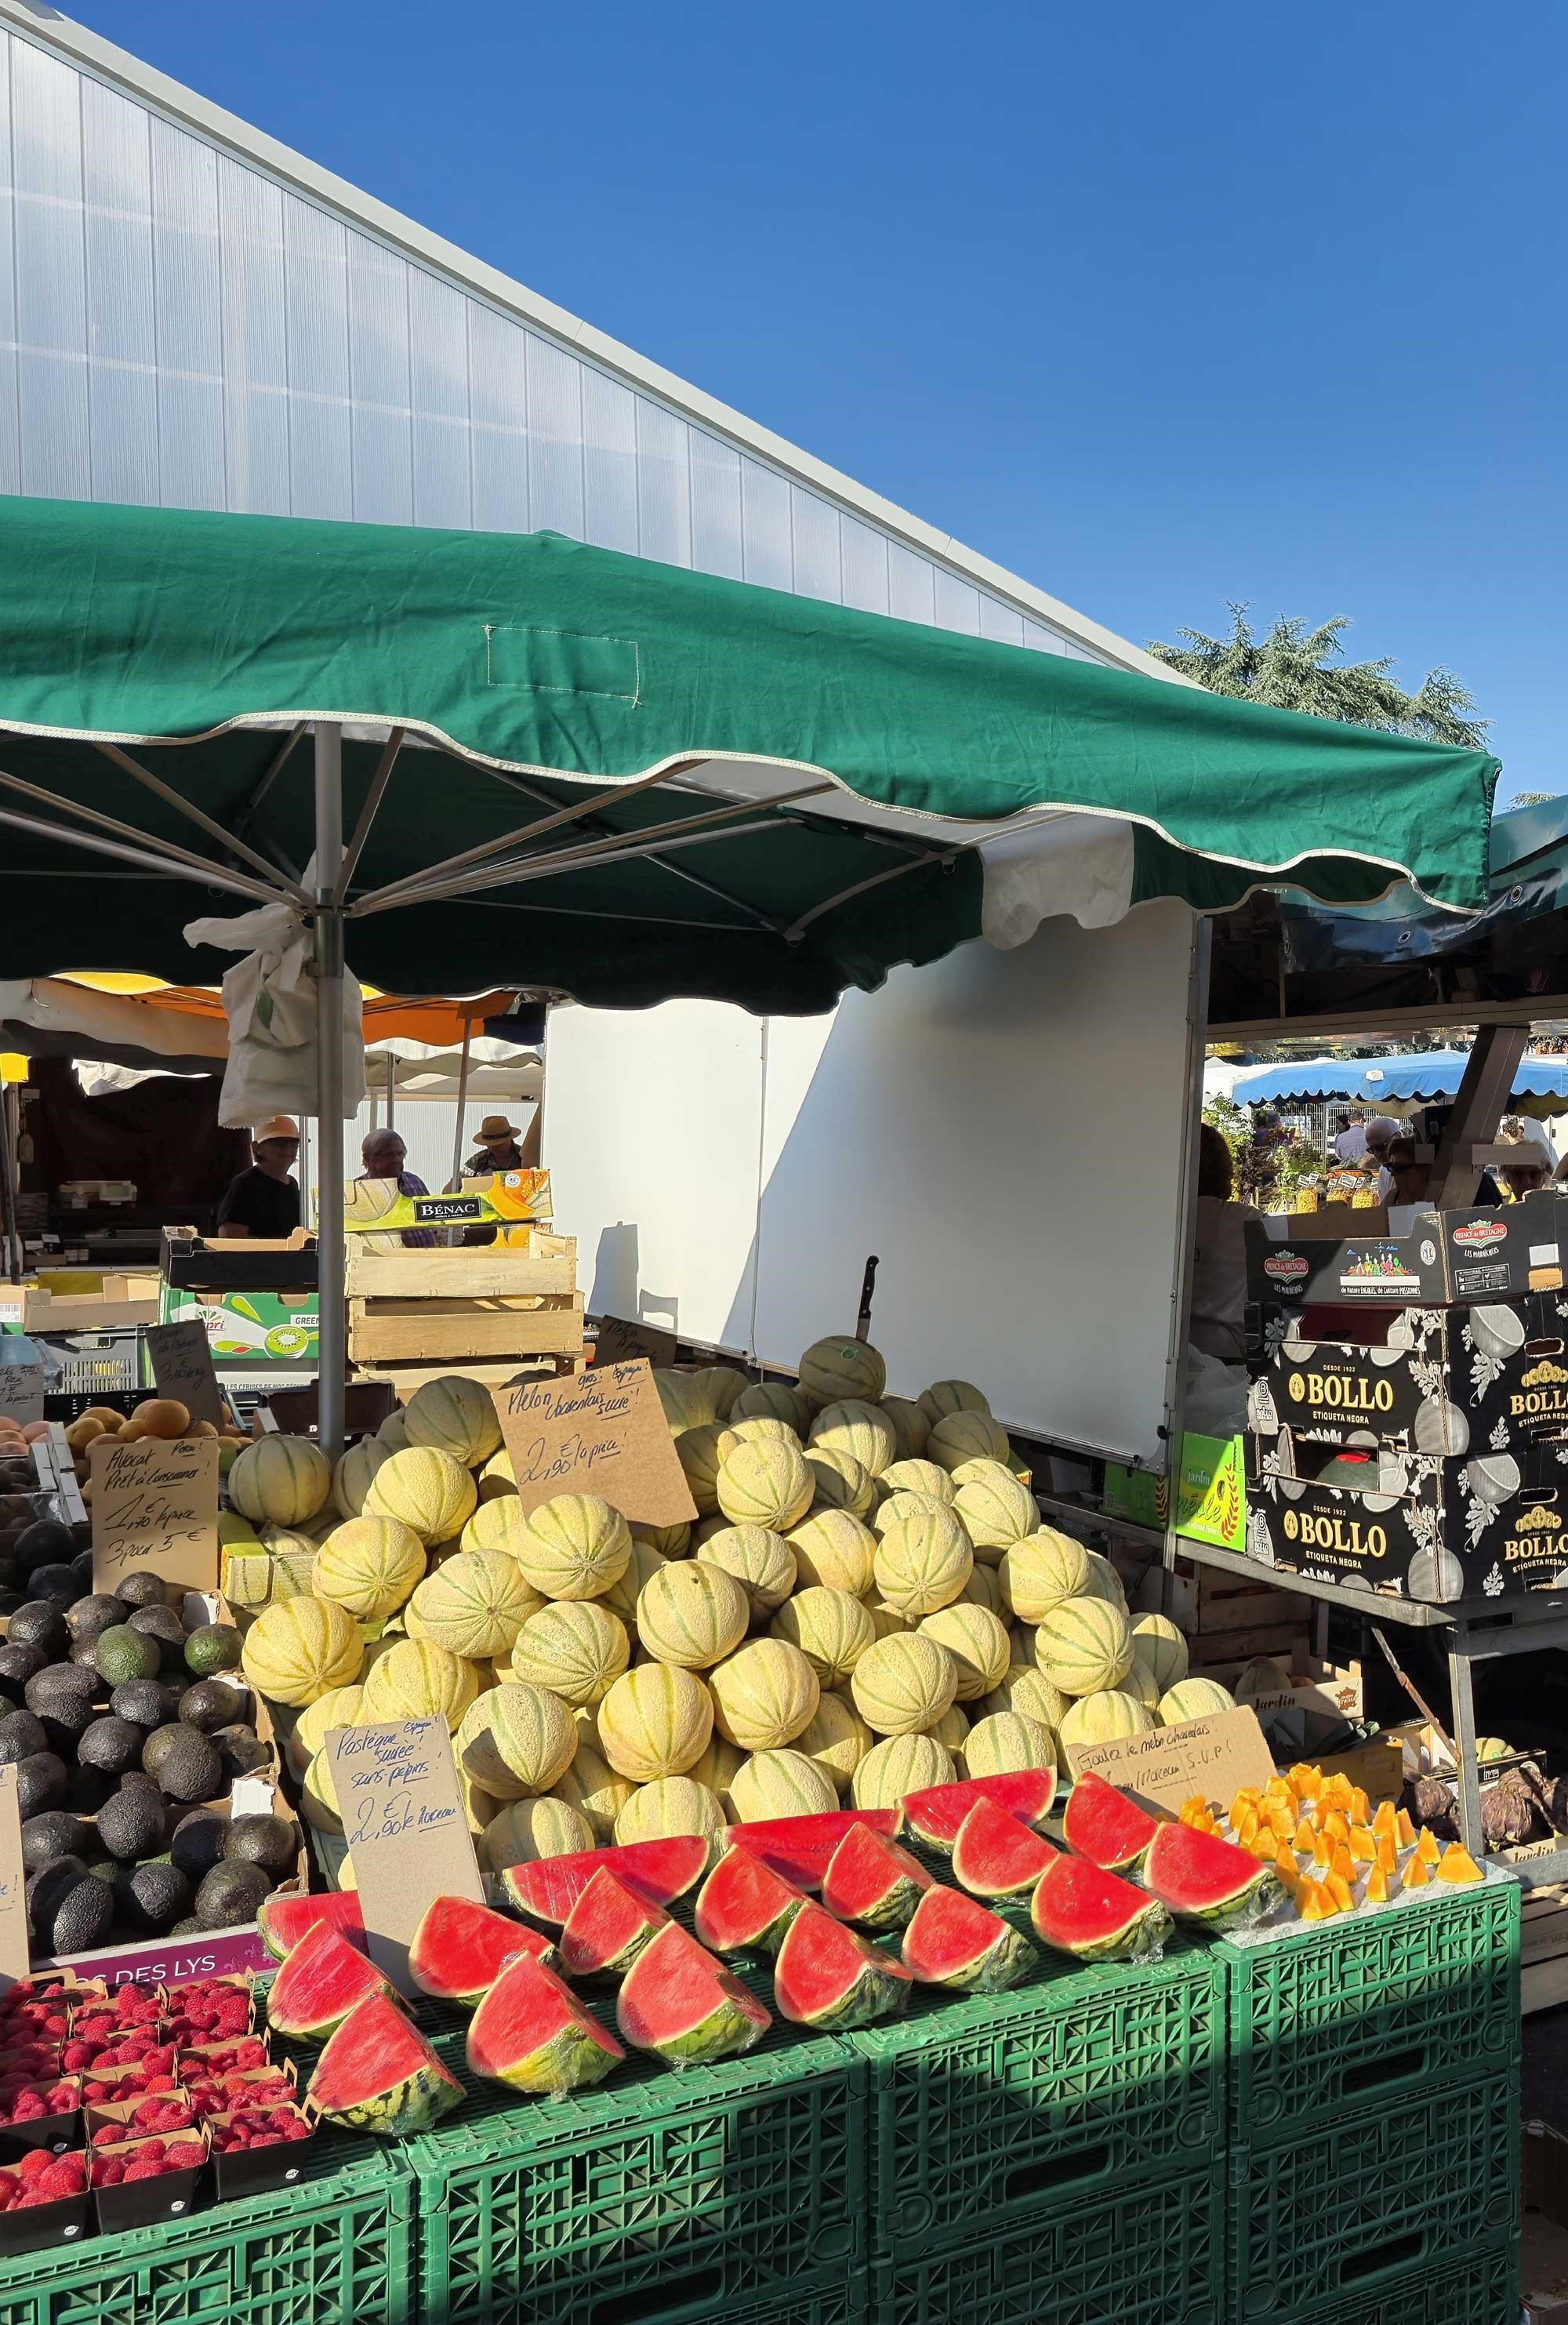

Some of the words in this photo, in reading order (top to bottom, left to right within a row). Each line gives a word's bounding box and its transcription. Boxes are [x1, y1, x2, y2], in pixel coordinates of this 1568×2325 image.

[421, 1204, 475, 1216] BÉNAC
[1455, 1230, 1473, 1239] PRINCE
[1479, 1227, 1505, 1237] BRETAGNE
[1266, 1262, 1281, 1271] PRINCE
[1285, 1262, 1307, 1271] BRETAGNE
[509, 1384, 552, 1415] Melon
[1307, 1374, 1394, 1411] BOLLO
[1312, 1411, 1345, 1422] ETIQUETA
[1346, 1415, 1370, 1425] NEGRA
[1519, 1414, 1552, 1427] ETIQUETA
[106, 1447, 156, 1472] Avocat
[1313, 1505, 1331, 1514] DESDE
[1299, 1513, 1387, 1558] BOLLO
[105, 1538, 124, 1564] 3
[1305, 1550, 1338, 1565] ETIQUETA
[1338, 1556, 1362, 1569] NEGRA
[1512, 1558, 1544, 1573] ETIQUETA
[1544, 1558, 1566, 1567] NEGRA
[1254, 1694, 1296, 1711] Jardin
[1126, 1742, 1138, 1758] le
[115, 1964, 167, 1987] DES
[174, 1955, 216, 1977] LYS
